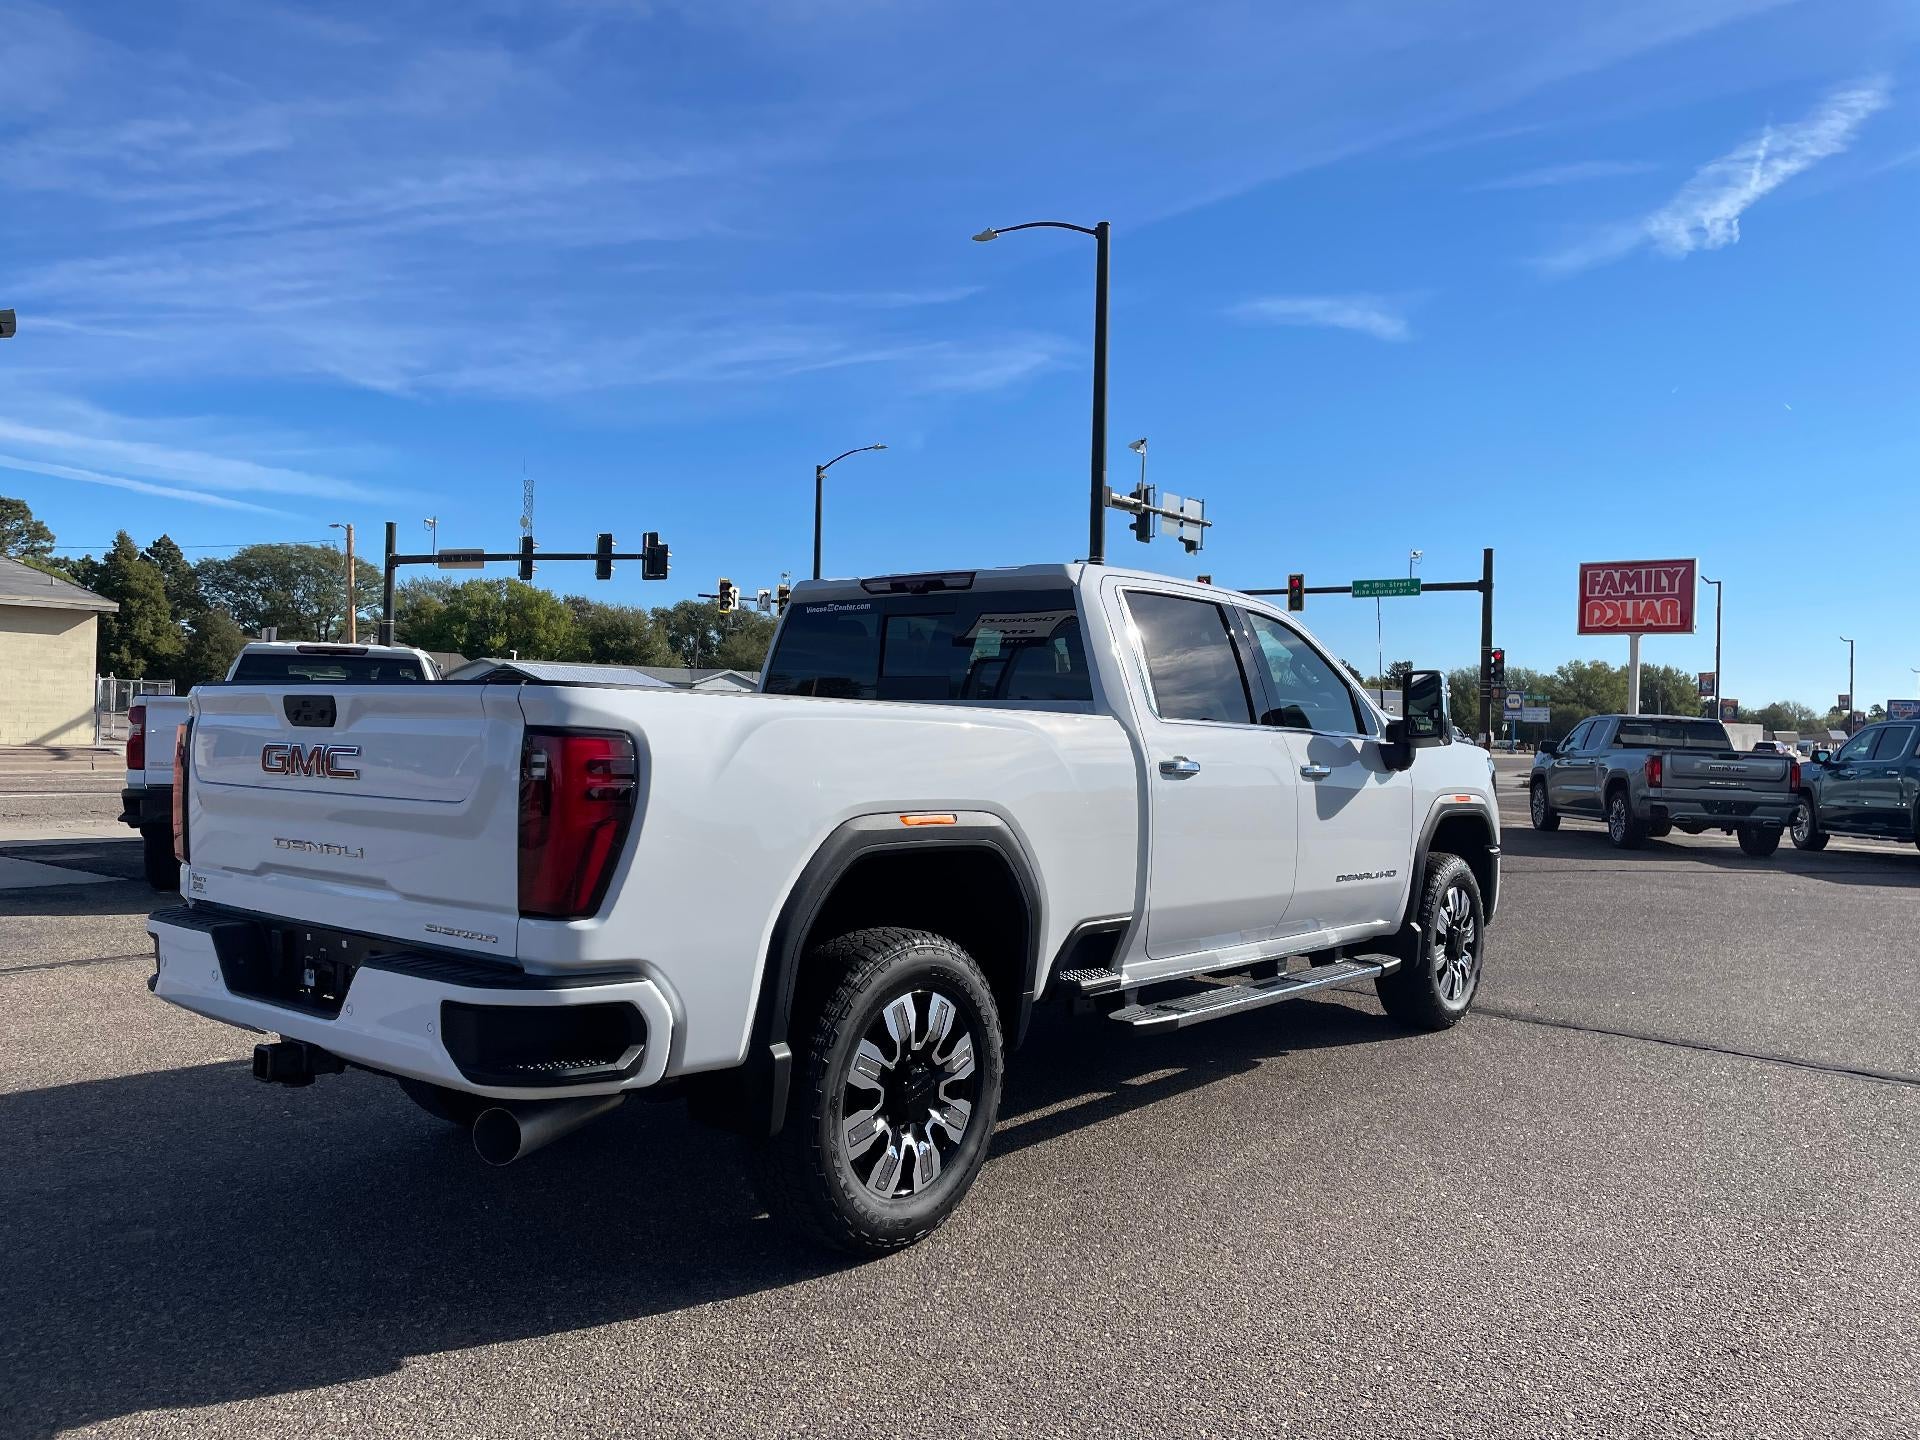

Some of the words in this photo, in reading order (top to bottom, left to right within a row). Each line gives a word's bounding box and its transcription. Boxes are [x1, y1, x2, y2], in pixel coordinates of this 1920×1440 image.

[1586, 567, 1687, 597] FAMILY
[1585, 598, 1680, 627] DOLLAR
[261, 742, 361, 780] GMC
[274, 837, 365, 859] DENALI
[1335, 871, 1379, 882] DENALI
[1380, 869, 1397, 879] HD
[424, 923, 498, 943] SIERRA
